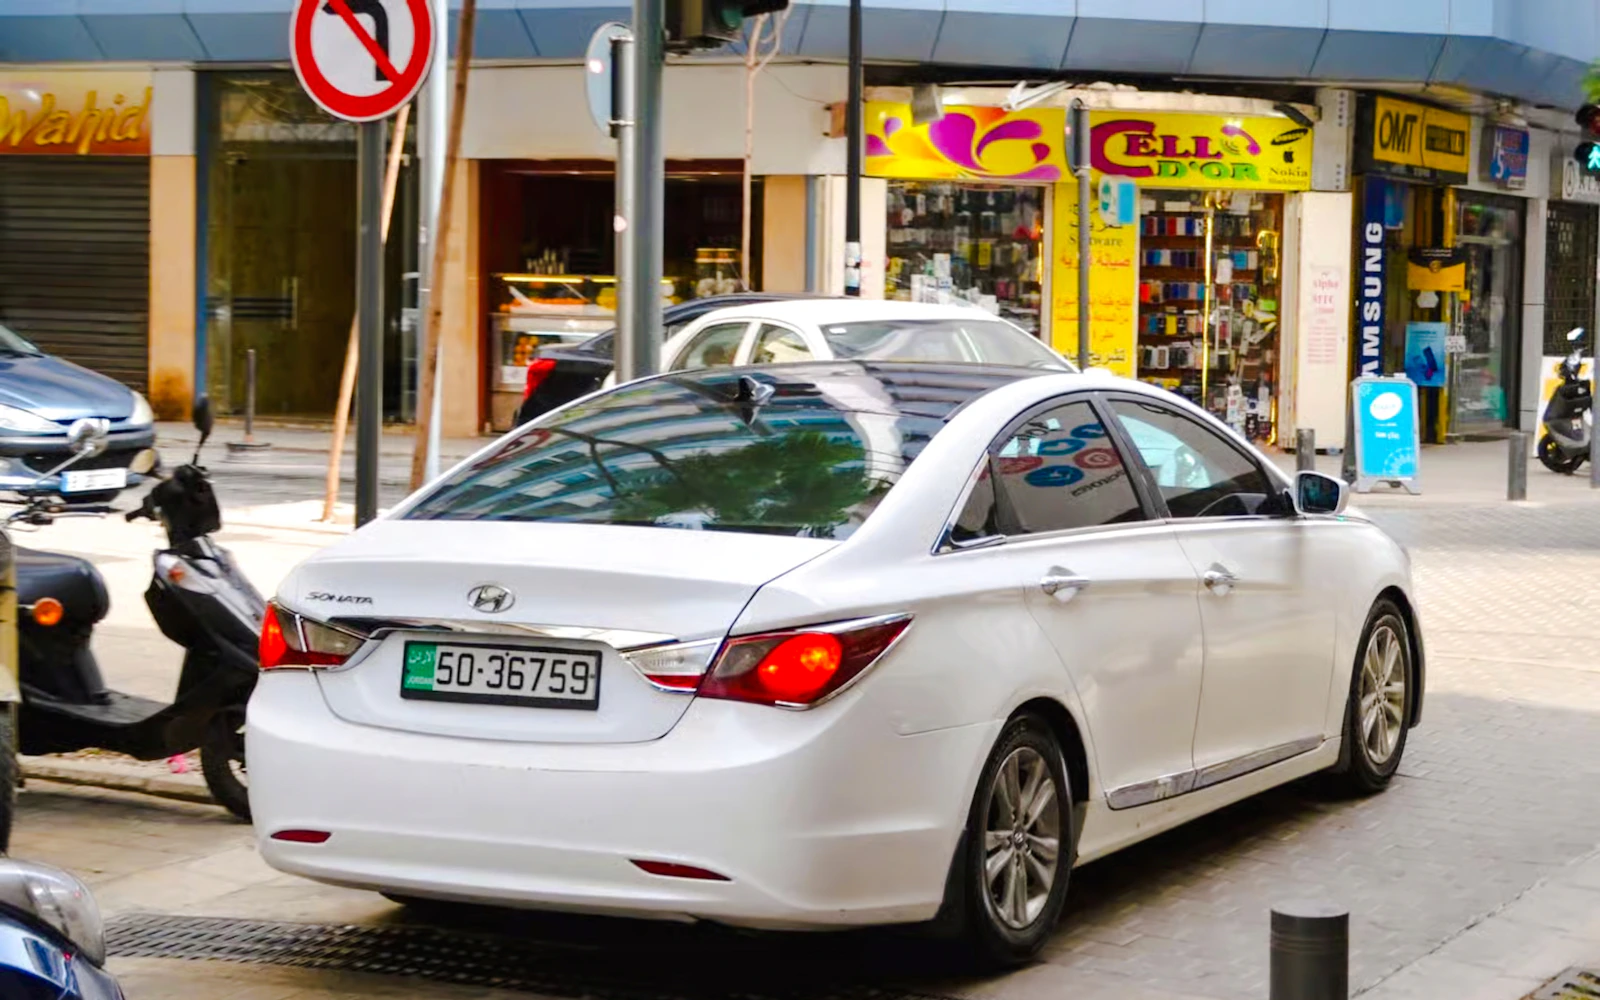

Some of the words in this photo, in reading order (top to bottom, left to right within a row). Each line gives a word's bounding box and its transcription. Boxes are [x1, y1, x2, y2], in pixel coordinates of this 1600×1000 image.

[1090, 119, 1223, 178] CELL
[1379, 111, 1418, 154] OMT
[1157, 160, 1261, 181] D'OR
[1269, 166, 1308, 177] Nokia
[1362, 222, 1383, 378] AMSUNG
[305, 591, 373, 605] SONATA
